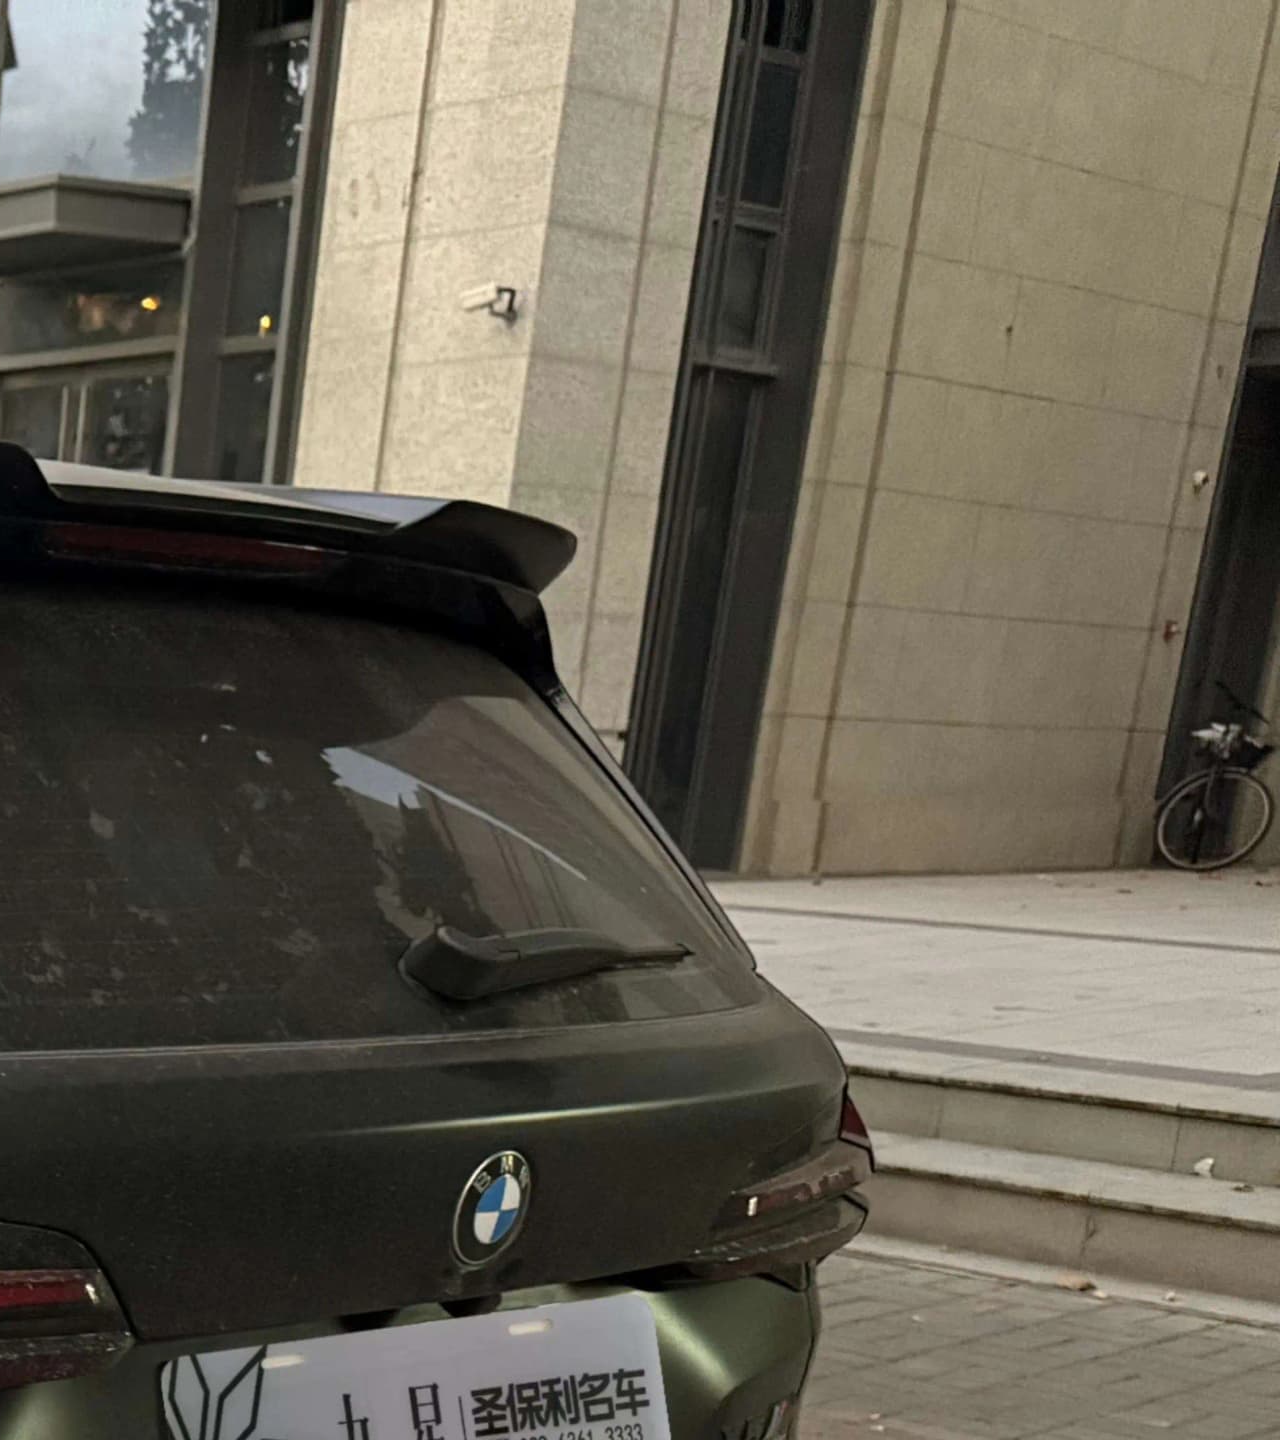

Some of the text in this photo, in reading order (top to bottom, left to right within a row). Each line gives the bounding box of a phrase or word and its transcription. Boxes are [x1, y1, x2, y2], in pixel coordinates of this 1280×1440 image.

[470, 1368, 650, 1437] 圣保利名车
